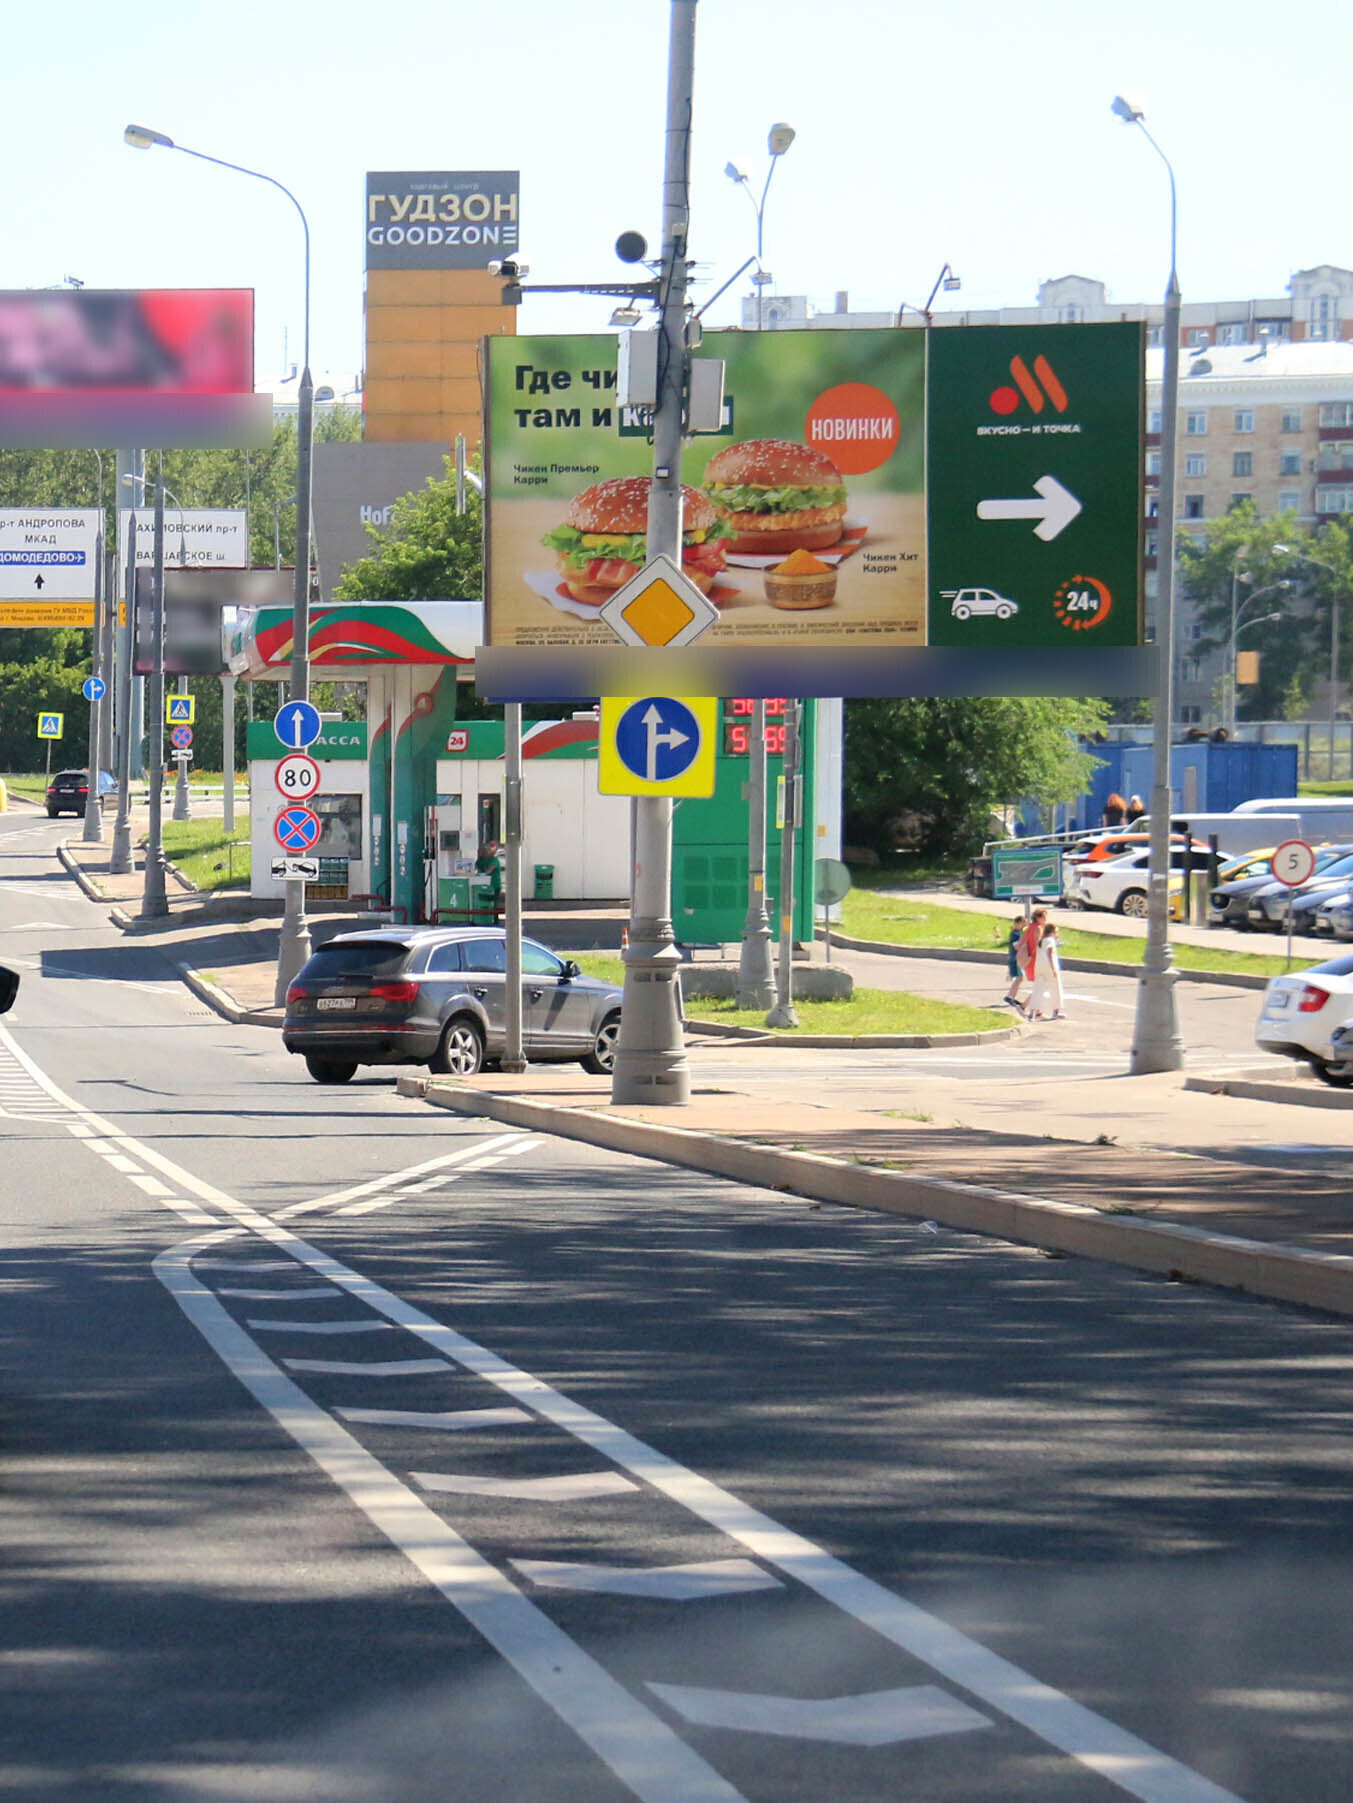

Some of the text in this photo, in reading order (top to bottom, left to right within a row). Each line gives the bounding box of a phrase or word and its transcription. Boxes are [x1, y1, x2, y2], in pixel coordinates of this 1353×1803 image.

[368, 193, 518, 223] ГУДЗОН
[367, 226, 517, 246] GOODZONE
[515, 365, 572, 395] Где
[514, 407, 581, 429] там
[592, 407, 612, 426] и
[811, 417, 894, 441] НОВИНКИ
[976, 426, 1021, 436] ВКУСНО
[1043, 424, 1081, 434] ТОЧКА
[513, 463, 600, 475] Чикен Премьер
[513, 475, 548, 485] Карри
[17, 519, 86, 529] АНДРОПОВА
[24, 534, 57, 545] МКАД
[863, 552, 919, 563] Чикен Хит
[863, 563, 898, 574] Карри
[316, 736, 361, 745] АССА
[450, 736, 464, 746] 24
[284, 769, 312, 787] 80
[1287, 853, 1299, 870] 5
[449, 892, 458, 908] 4
